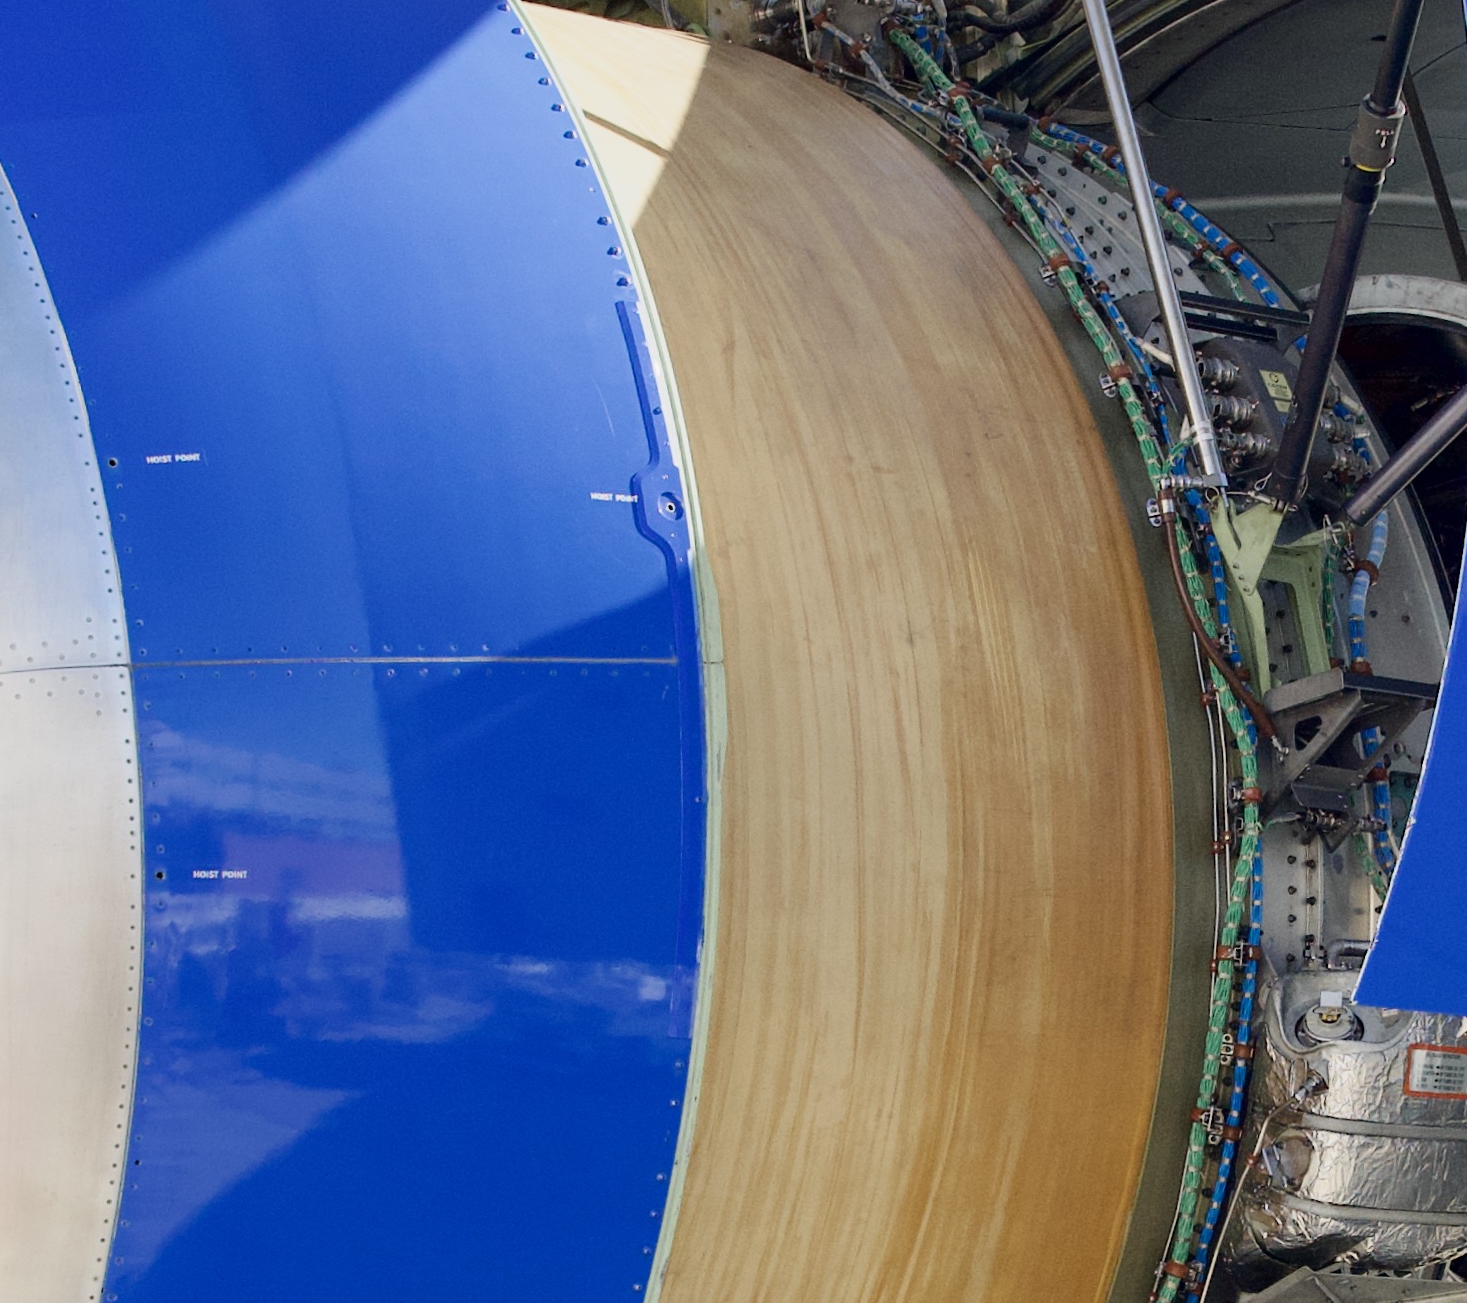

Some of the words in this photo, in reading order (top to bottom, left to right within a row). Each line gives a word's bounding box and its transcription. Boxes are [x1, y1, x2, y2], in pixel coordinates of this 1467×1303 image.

[146, 454, 172, 464] HOIST
[174, 452, 200, 462] POINT
[590, 492, 613, 502] HOIST
[615, 493, 638, 503] POINT
[192, 870, 219, 879] HOIST
[221, 870, 248, 879] POINT
